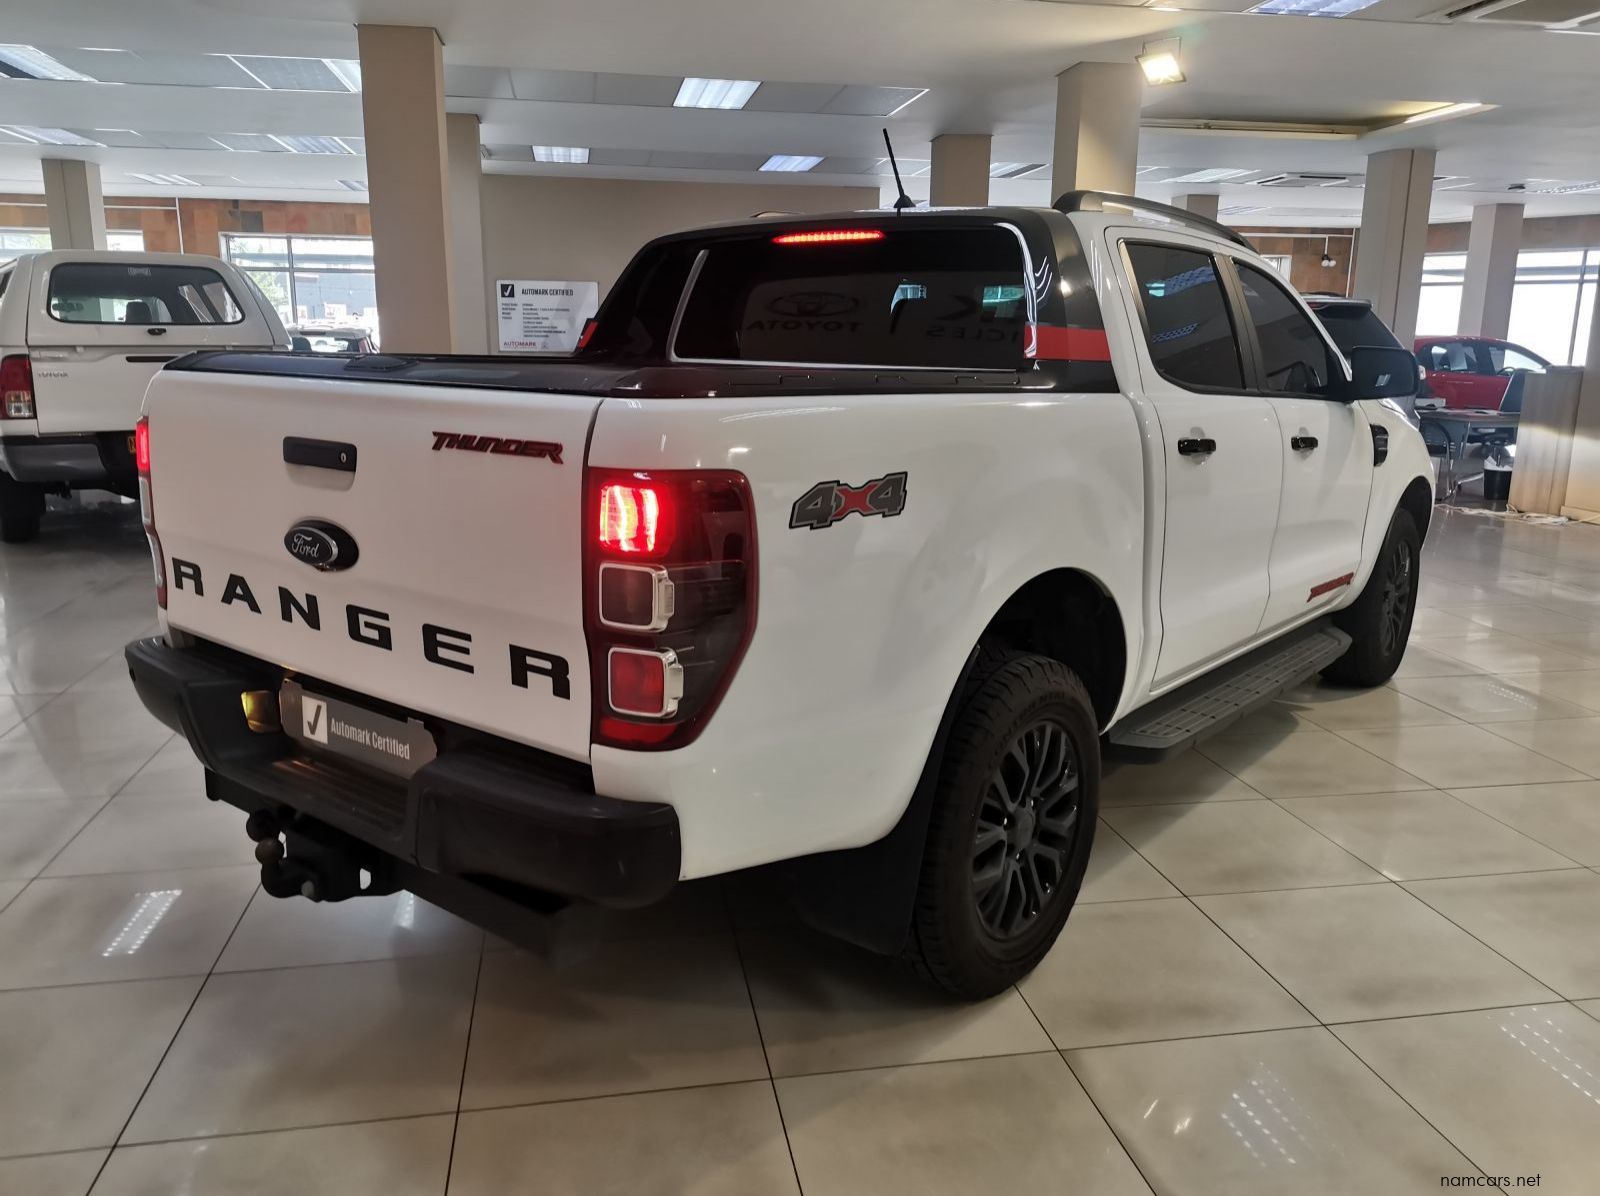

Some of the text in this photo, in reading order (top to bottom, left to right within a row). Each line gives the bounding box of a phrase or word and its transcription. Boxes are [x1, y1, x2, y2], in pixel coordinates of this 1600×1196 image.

[521, 288, 548, 296] AUTOMARK
[431, 431, 564, 465] THUNDER
[291, 533, 320, 558] Ford
[171, 556, 571, 701] RANGER
[331, 717, 410, 760] Automark Certified
